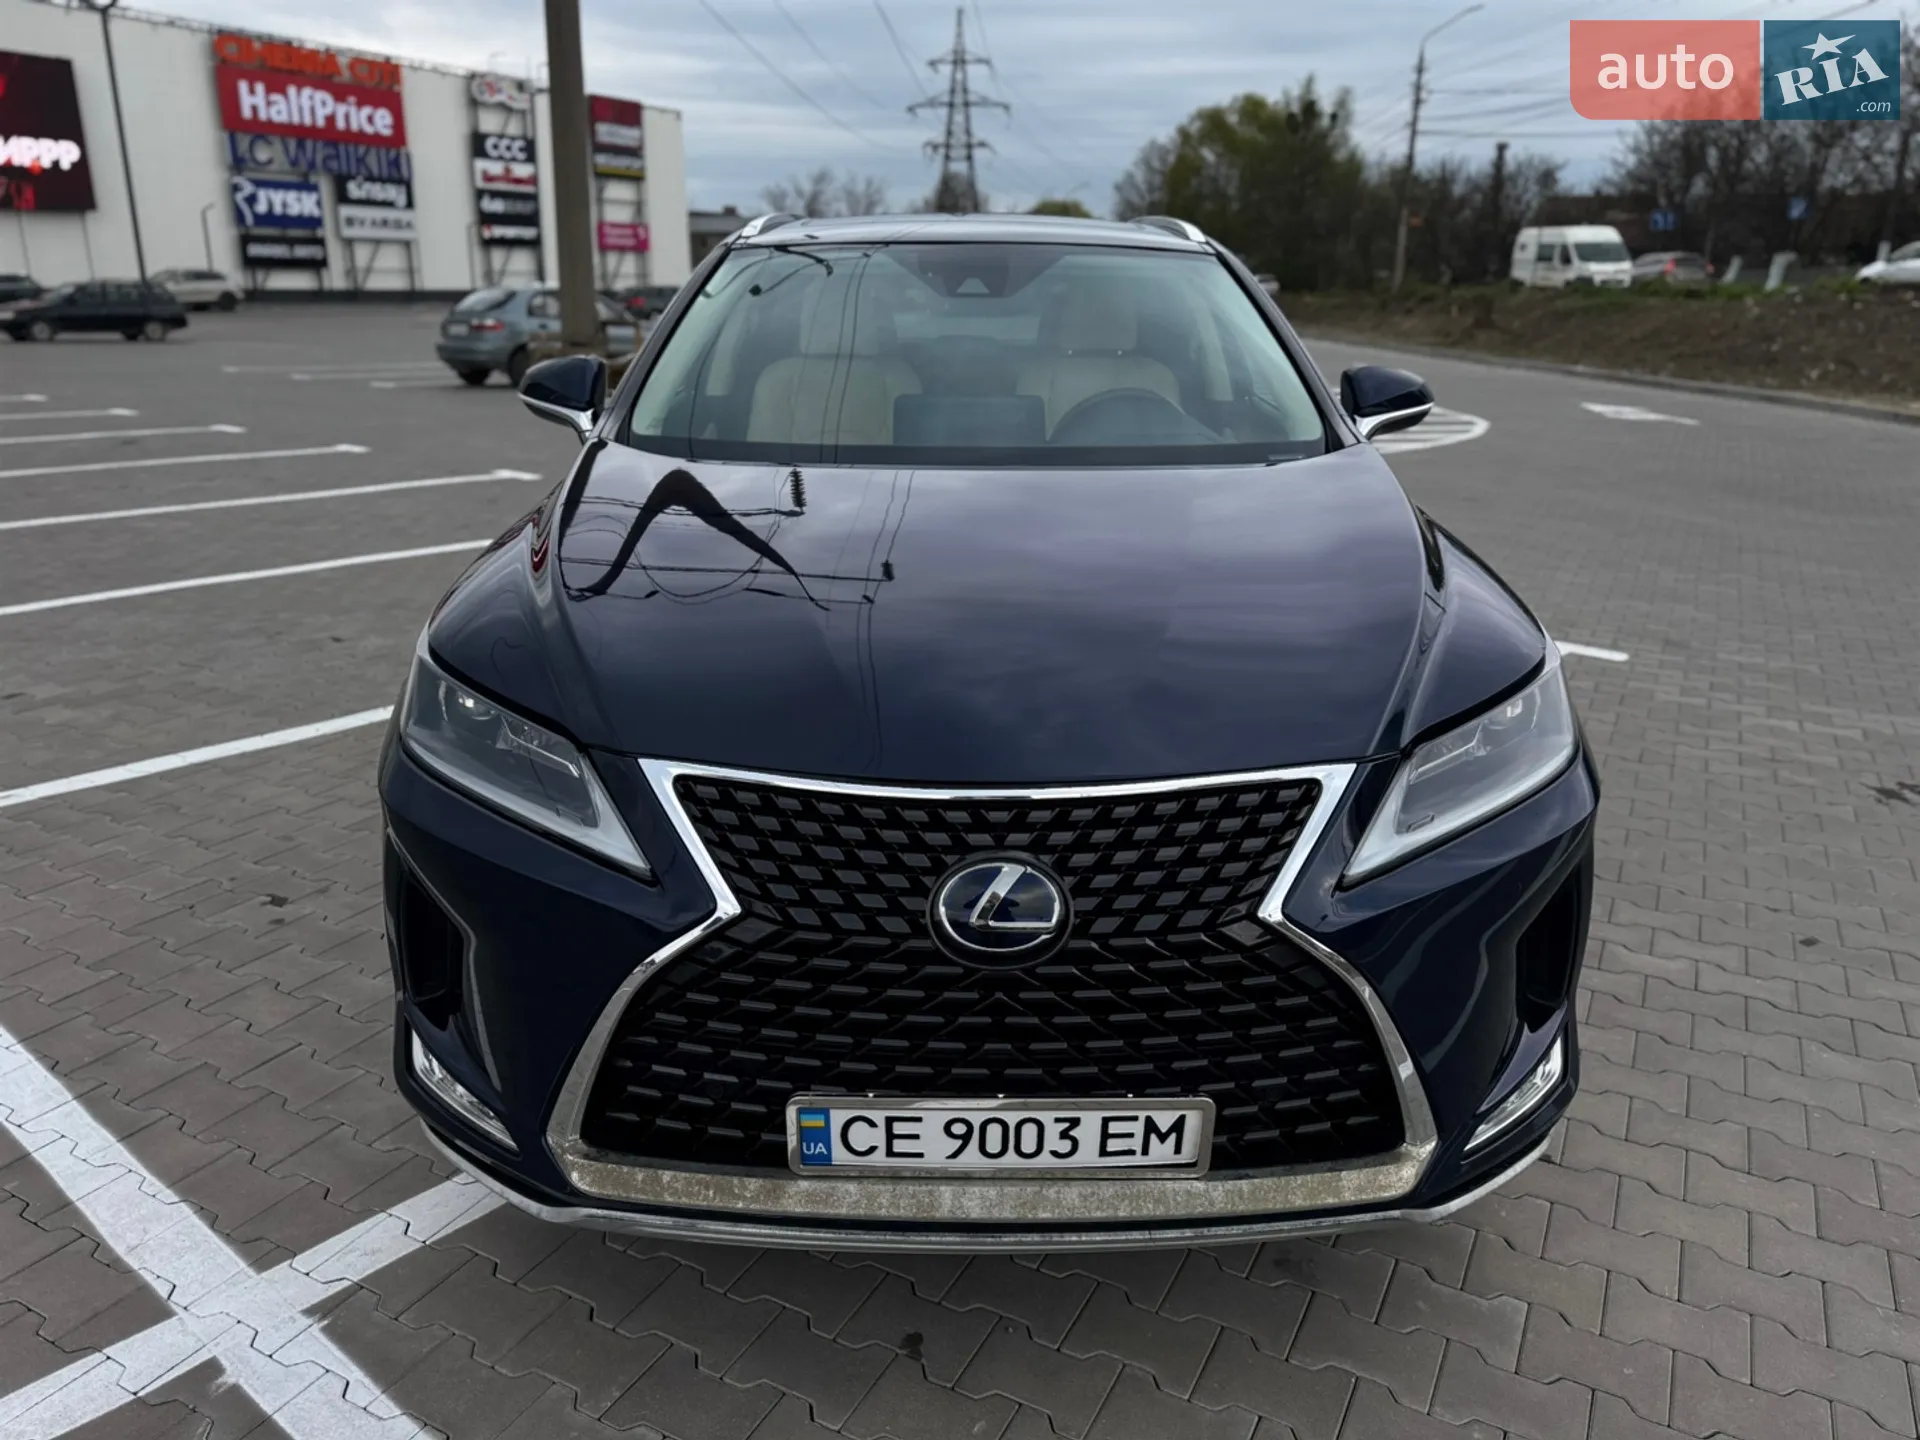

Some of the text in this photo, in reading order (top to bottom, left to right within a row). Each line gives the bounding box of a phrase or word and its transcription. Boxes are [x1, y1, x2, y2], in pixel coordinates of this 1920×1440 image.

[237, 79, 394, 137] HalfPrice
[485, 136, 528, 161] CCC
[253, 190, 321, 218] JYSK
[802, 1141, 828, 1156] UA
[840, 1113, 1187, 1160] CE 9003 EM
